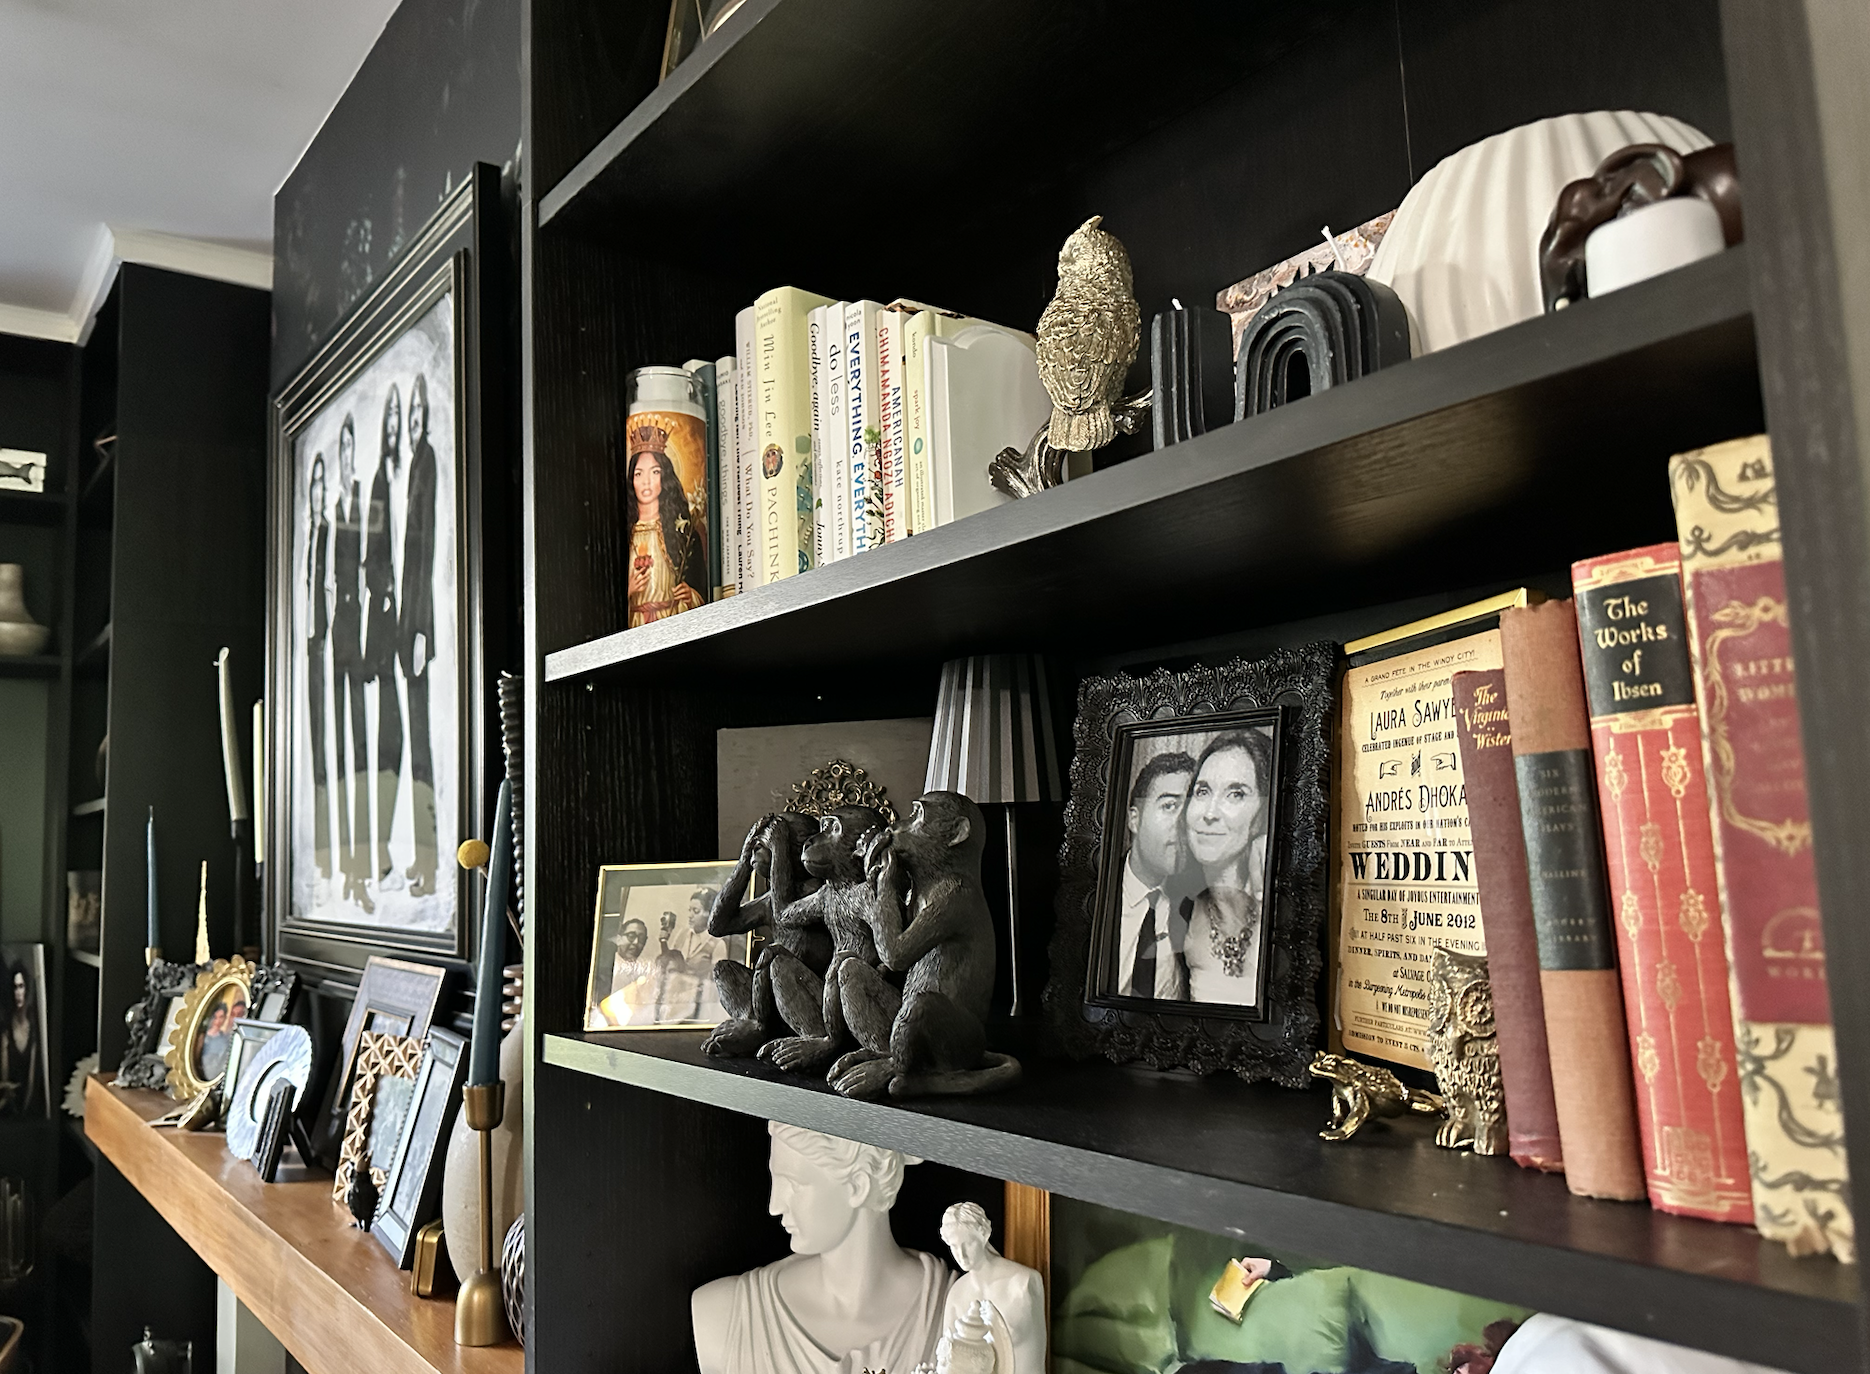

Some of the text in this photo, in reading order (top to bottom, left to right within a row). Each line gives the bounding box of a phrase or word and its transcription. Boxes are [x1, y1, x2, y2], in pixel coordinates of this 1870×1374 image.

[847, 308, 862, 319] nicola
[848, 319, 860, 331] yoon
[763, 334, 776, 437] Min Jin Lee
[810, 323, 822, 431] Goodbye, again
[830, 344, 843, 416] do less
[879, 328, 895, 543] CHIMAMANDA NGOZI ADICHI
[892, 386, 904, 488] AMERICANAH
[719, 400, 729, 506] goodbye, things
[746, 502, 753, 519] Do
[853, 463, 866, 554] EVERYTH
[746, 523, 754, 545] You
[768, 487, 779, 582] PACHINK
[837, 495, 845, 554] northrup
[816, 521, 825, 558] Jonny
[746, 550, 755, 578] Say?
[1603, 595, 1648, 621] The
[1595, 622, 1668, 650] Works
[1371, 671, 1389, 683] GRAND
[1434, 655, 1454, 666] WINDY
[1457, 650, 1475, 660] CITY!
[1622, 649, 1642, 676] of
[1734, 656, 1795, 677] LITTL
[1380, 678, 1452, 701] Together with their paren
[1474, 683, 1498, 706] The
[1612, 681, 1663, 701] Ibsen
[1371, 697, 1456, 741] LAURA SAWYE
[1459, 707, 1510, 732] Virginia
[1362, 731, 1455, 753] CELEBRATED INGENUE OF STAGE AND
[1537, 786, 1579, 796] ODERN
[1366, 787, 1412, 823] ANDRÉS
[1353, 823, 1367, 832] NOTED
[1370, 823, 1378, 832] FOR
[1380, 822, 1388, 831] HIS
[1390, 821, 1413, 831] EXPLOITS
[1416, 821, 1421, 829] IN
[1436, 816, 1462, 828] NATION'S
[1362, 840, 1385, 848] GUESTS
[1401, 839, 1420, 848] NEAR
[1433, 838, 1447, 847] FAR
[1349, 851, 1473, 882] WEDDIN
[1358, 889, 1479, 905] A SINGULAR DAY OF JOYOUS ENTERTAINMENT
[1381, 909, 1399, 924] 8TH
[1409, 911, 1442, 931] JUNE
[1447, 913, 1476, 929] 2012
[1369, 931, 1385, 941] HALF
[1387, 934, 1403, 943] PAST
[1405, 935, 1416, 945] SIX
[1418, 936, 1425, 945] IN
[1428, 937, 1442, 947] THE
[1445, 939, 1480, 951] EVENING
[1403, 953, 1418, 961] AND
[1393, 969, 1399, 978] at
[1400, 966, 1425, 982] SALVAGE
[1354, 980, 1362, 989] the
[1363, 979, 1393, 998] Burgeoning
[1394, 985, 1426, 1001] Metropolis
[1349, 1030, 1375, 1041] ADMISSION
[1377, 1035, 1384, 1043] TO
[1385, 1038, 1403, 1049] EVENT
